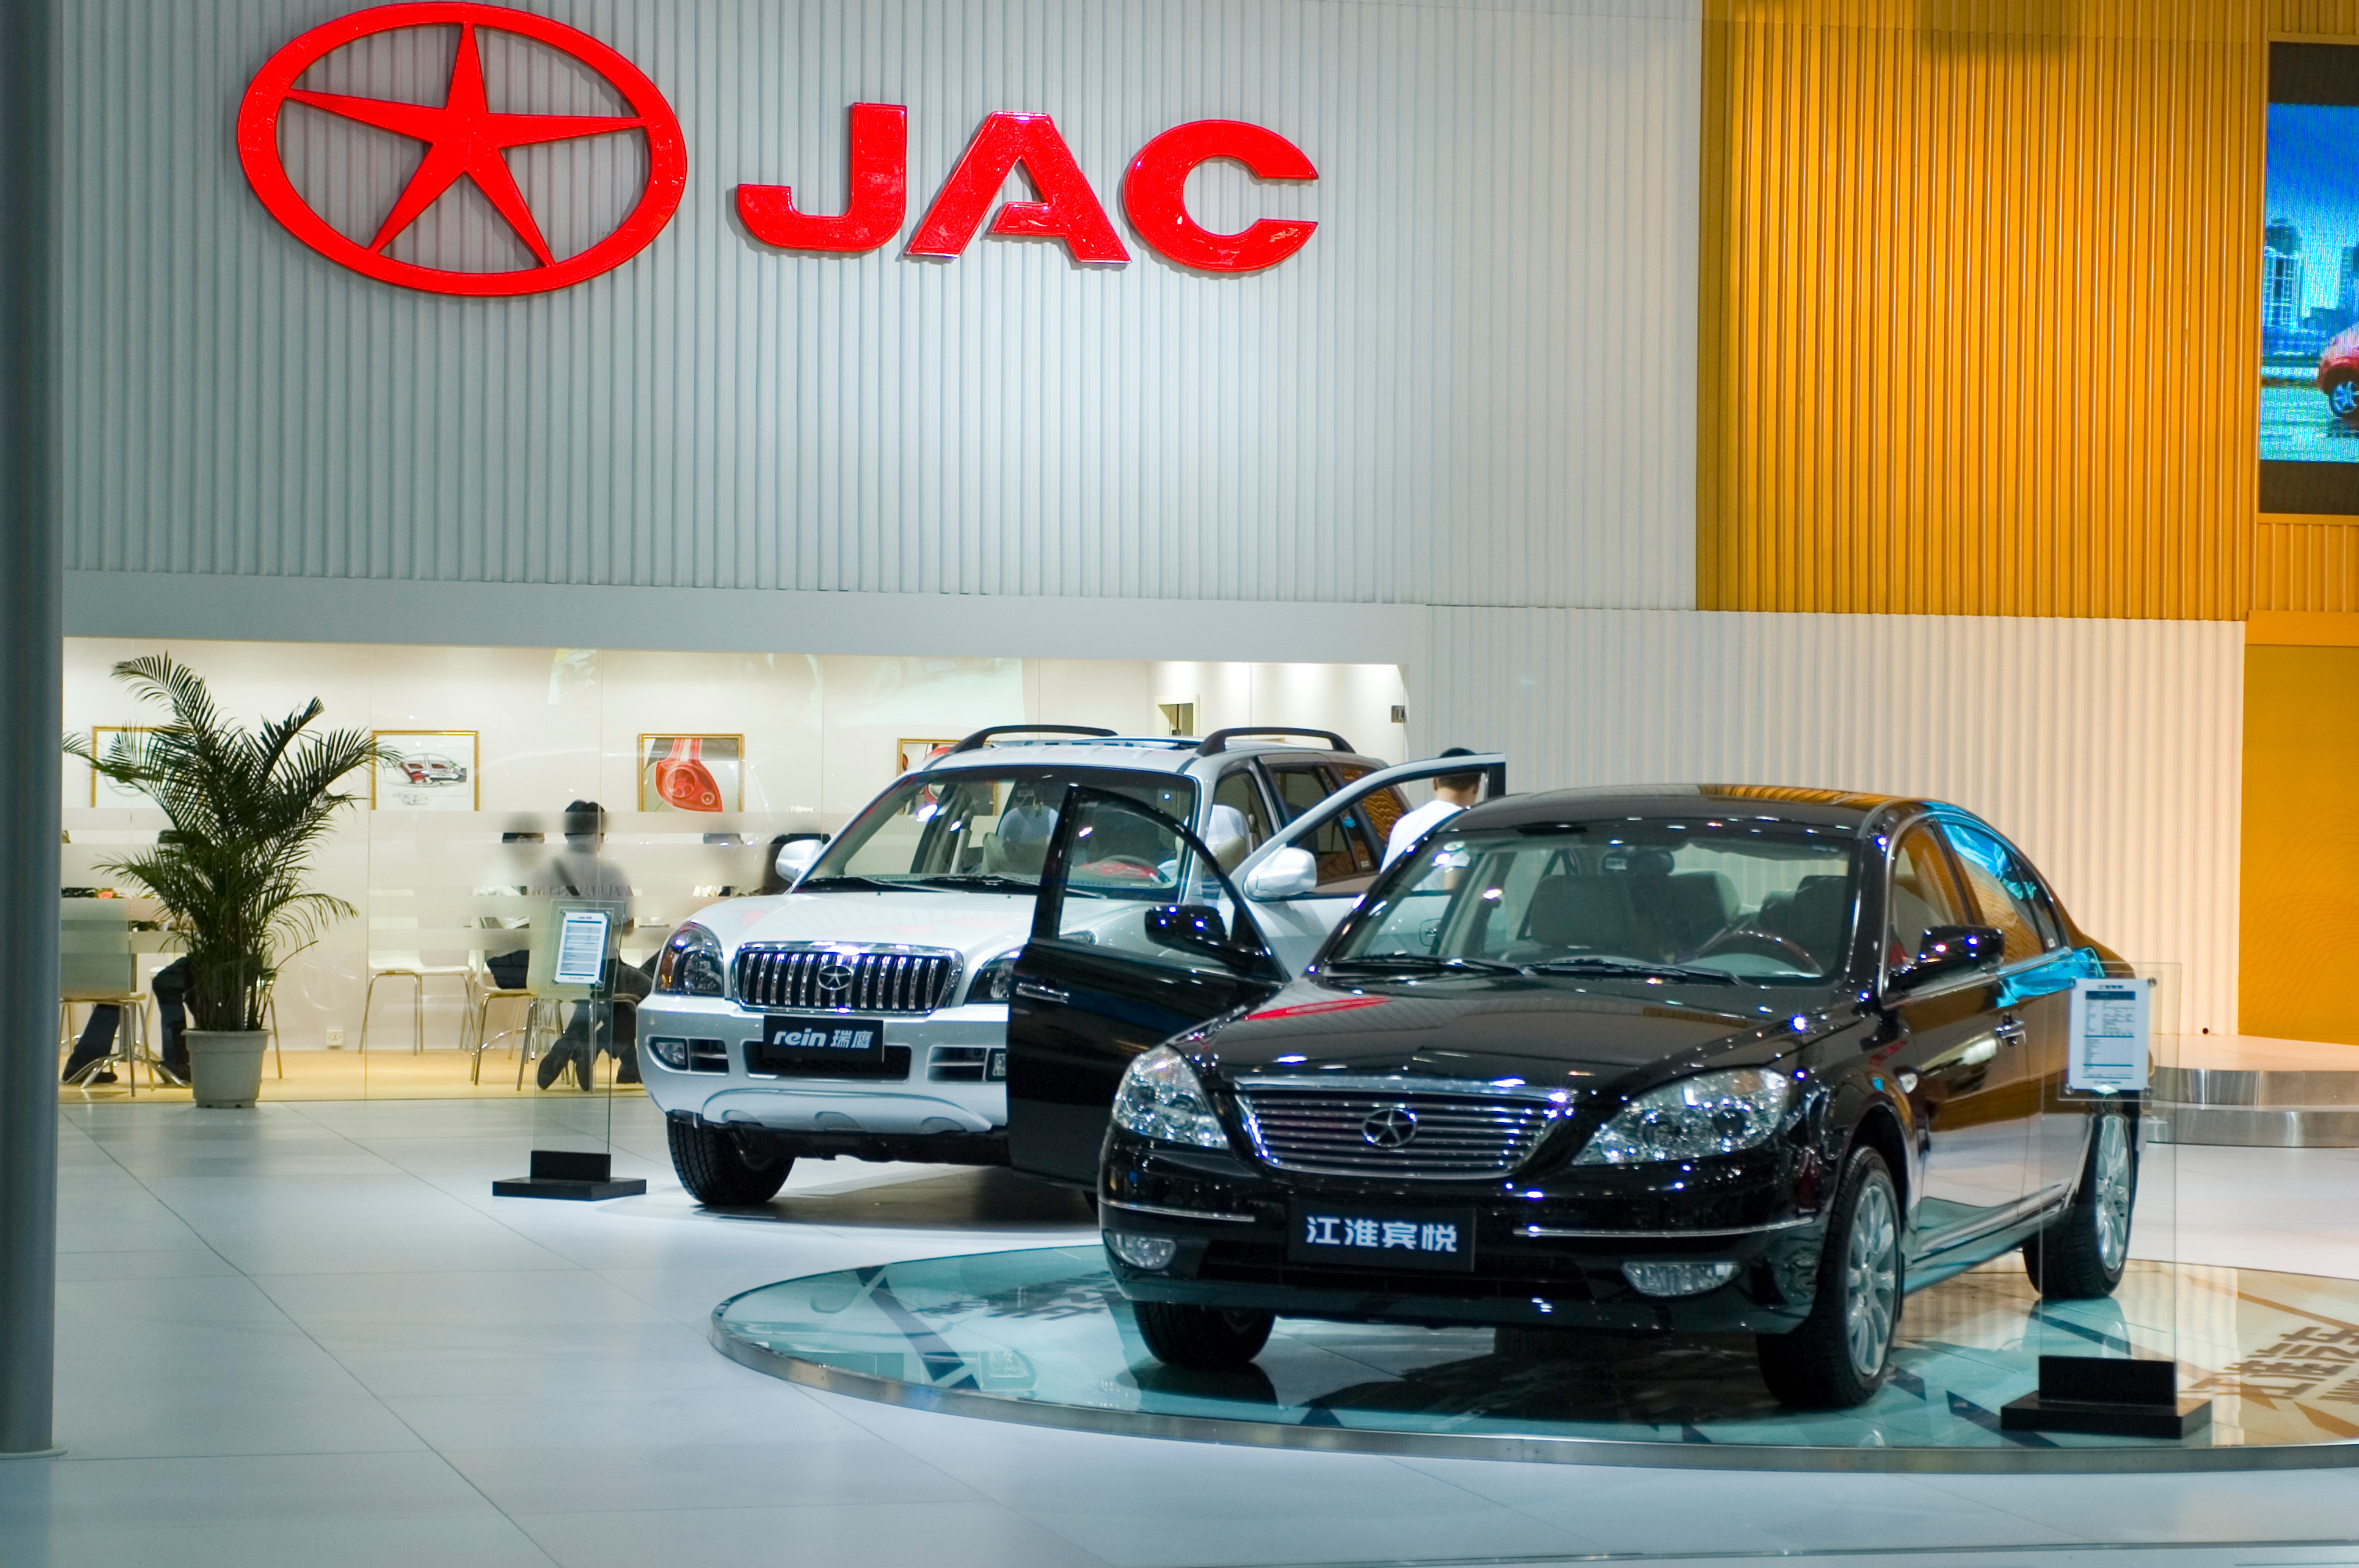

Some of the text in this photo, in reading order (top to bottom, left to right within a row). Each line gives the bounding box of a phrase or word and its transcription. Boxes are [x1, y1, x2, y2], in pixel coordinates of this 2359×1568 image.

[737, 102, 1319, 274] JAC
[772, 1027, 874, 1049] rein 瑞鹰
[1305, 1215, 1458, 1253] 江淮宾悦
